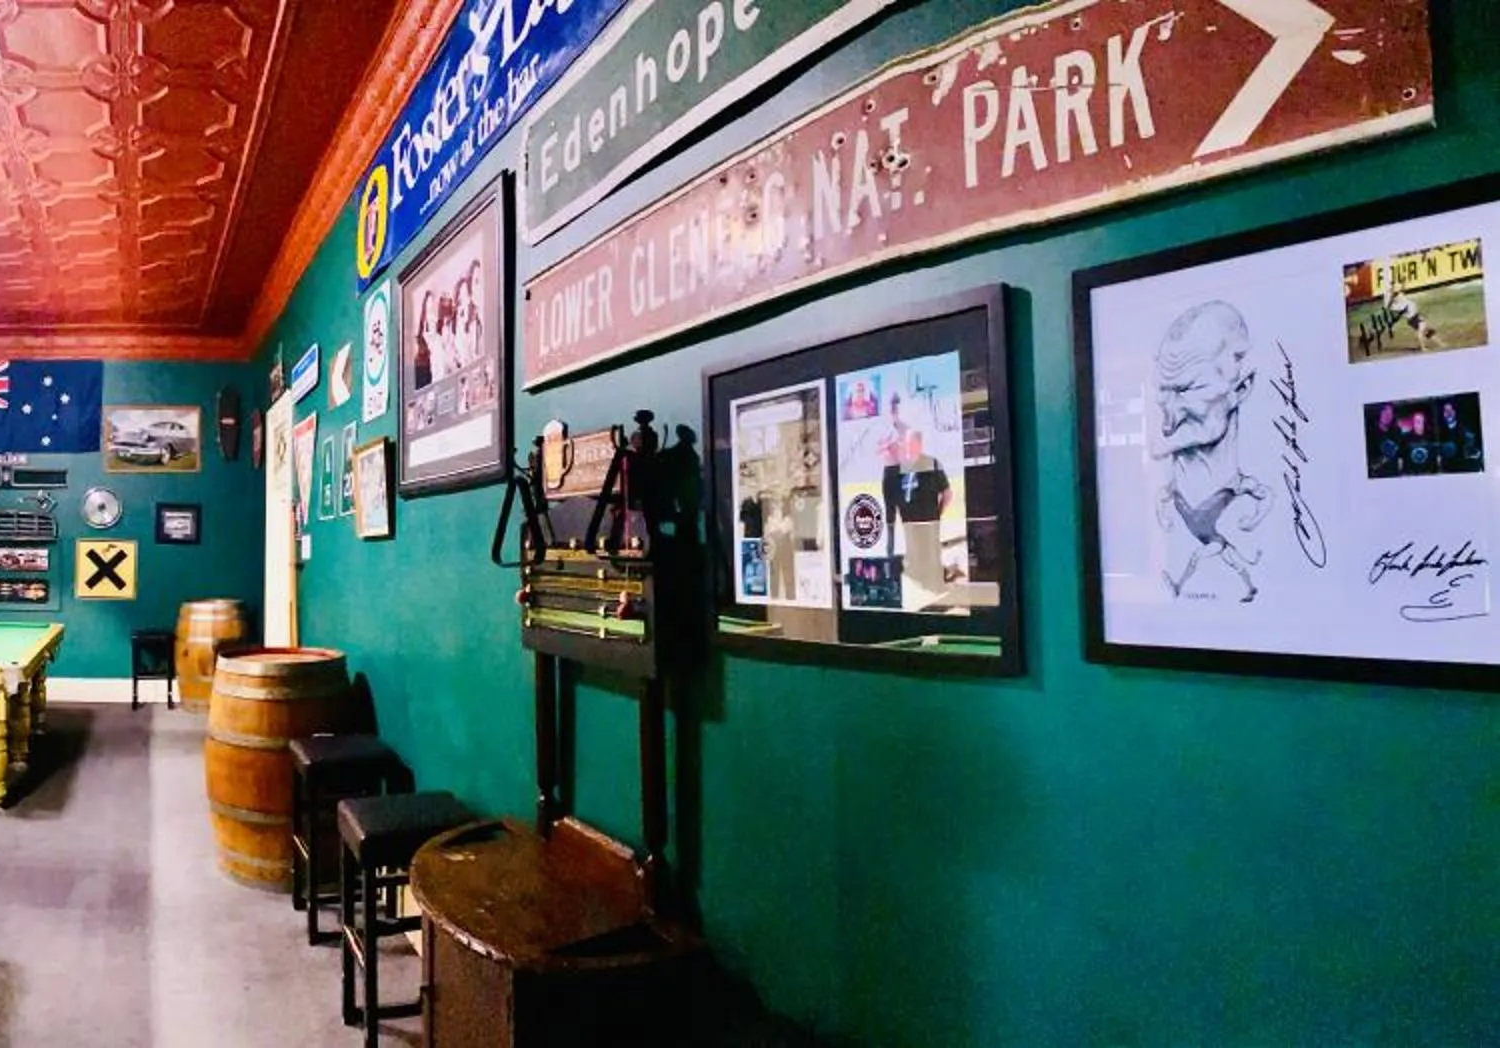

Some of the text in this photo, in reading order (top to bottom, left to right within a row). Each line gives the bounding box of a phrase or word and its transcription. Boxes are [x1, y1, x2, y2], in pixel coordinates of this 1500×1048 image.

[477, 98, 506, 146] the
[539, 264, 614, 357] LOWER
[962, 22, 1156, 189] PARK
[541, 0, 761, 193] Edenhope
